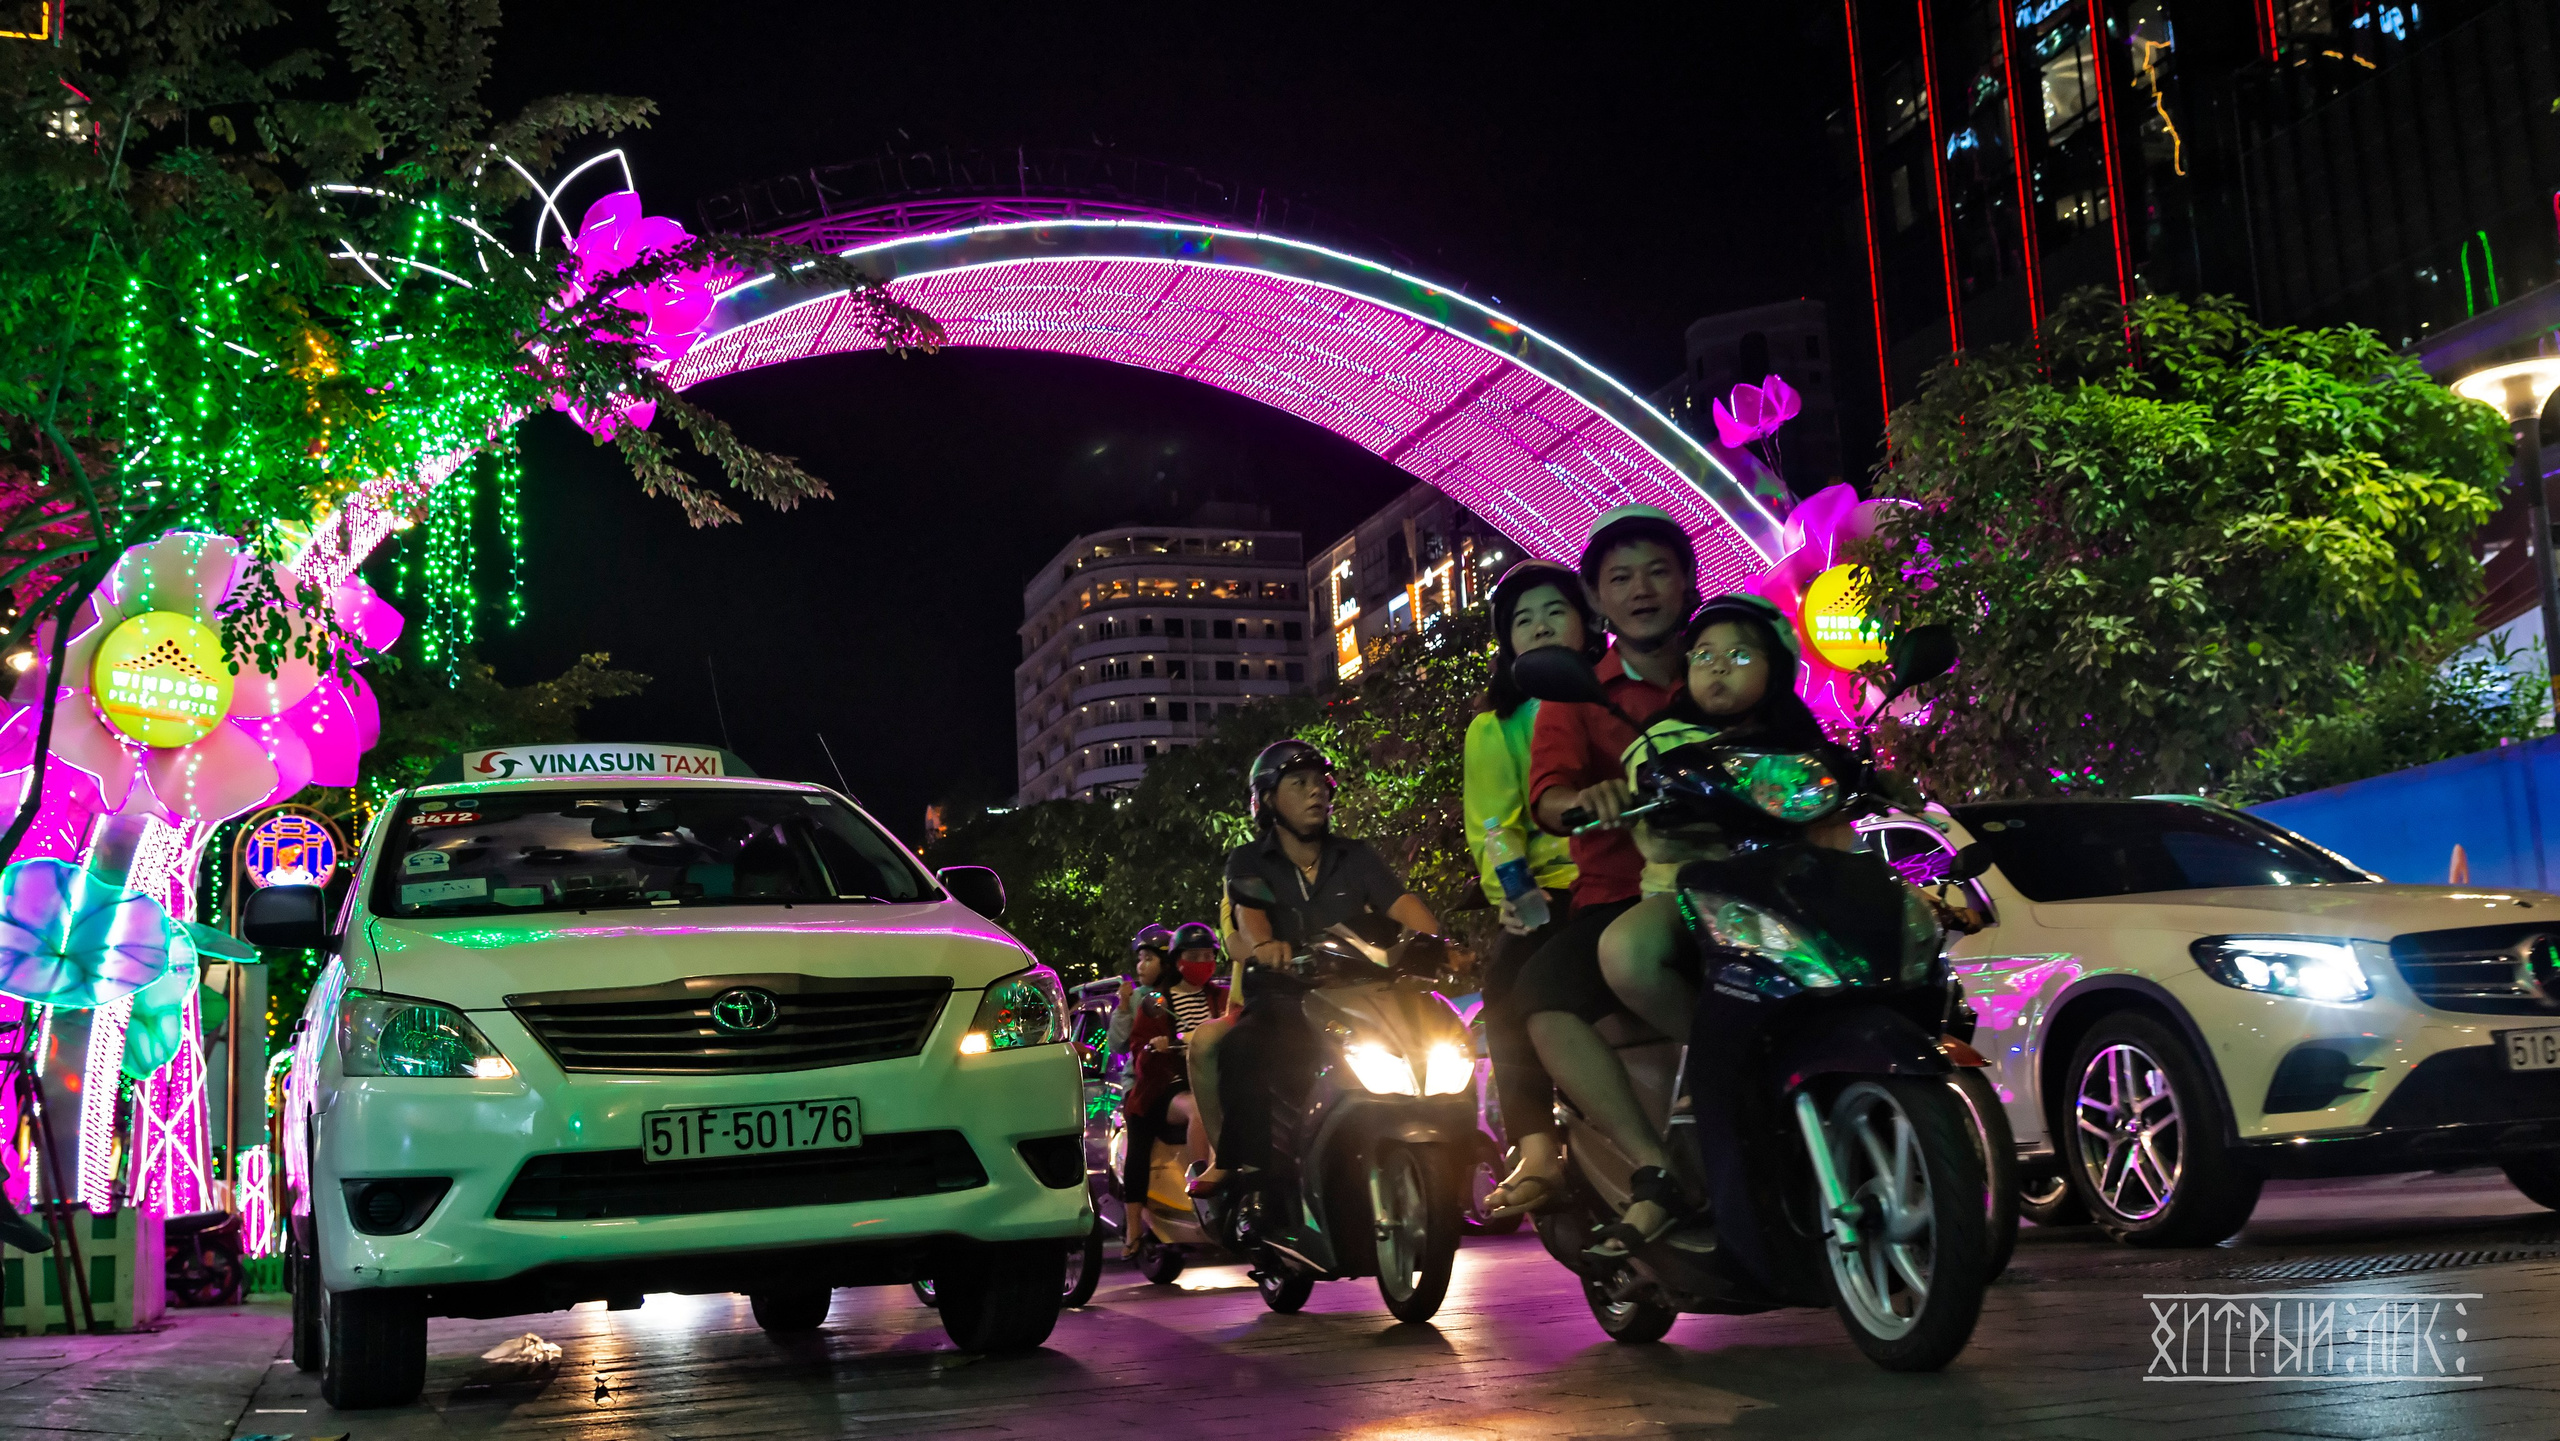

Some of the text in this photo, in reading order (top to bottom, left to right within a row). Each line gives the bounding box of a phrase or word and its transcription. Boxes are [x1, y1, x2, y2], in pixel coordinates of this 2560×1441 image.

[112, 670, 219, 701] WINDSOR
[108, 689, 158, 708] PLAZA
[168, 699, 217, 716] HOTEL
[528, 752, 716, 775] VINASUN TAXI
[411, 811, 473, 825] 8472
[651, 1105, 853, 1156] 51F-501.76
